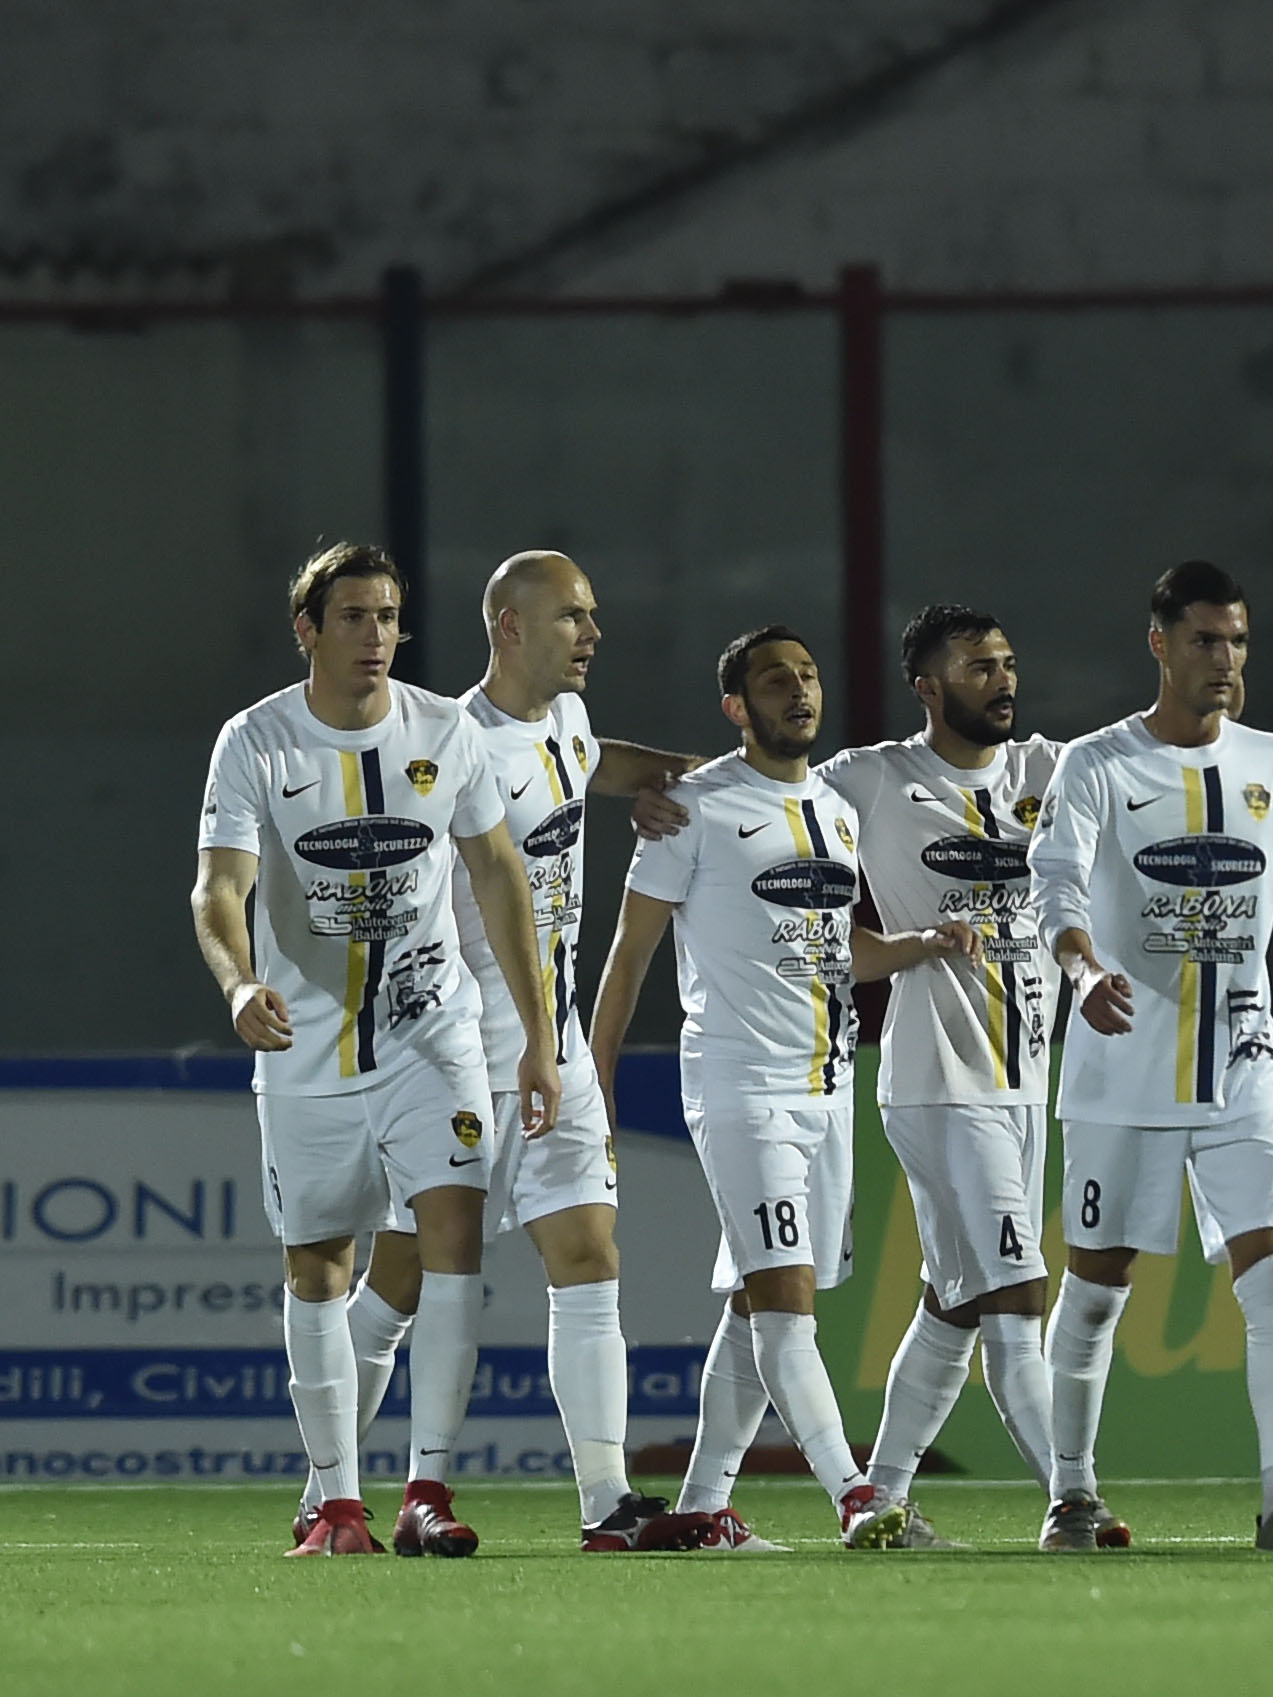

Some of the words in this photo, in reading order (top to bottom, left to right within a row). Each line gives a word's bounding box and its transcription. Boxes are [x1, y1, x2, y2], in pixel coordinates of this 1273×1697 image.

[298, 837, 359, 851] TECNOLOGIA
[374, 837, 429, 852] SICUREZZA
[1138, 853, 1197, 867] TECNOLOGIA
[755, 878, 812, 892] TECNOLOGIA
[1141, 894, 1258, 918] RABONA
[1081, 1179, 1101, 1228] 8
[753, 1199, 799, 1250] 18
[999, 1214, 1023, 1261] 4
